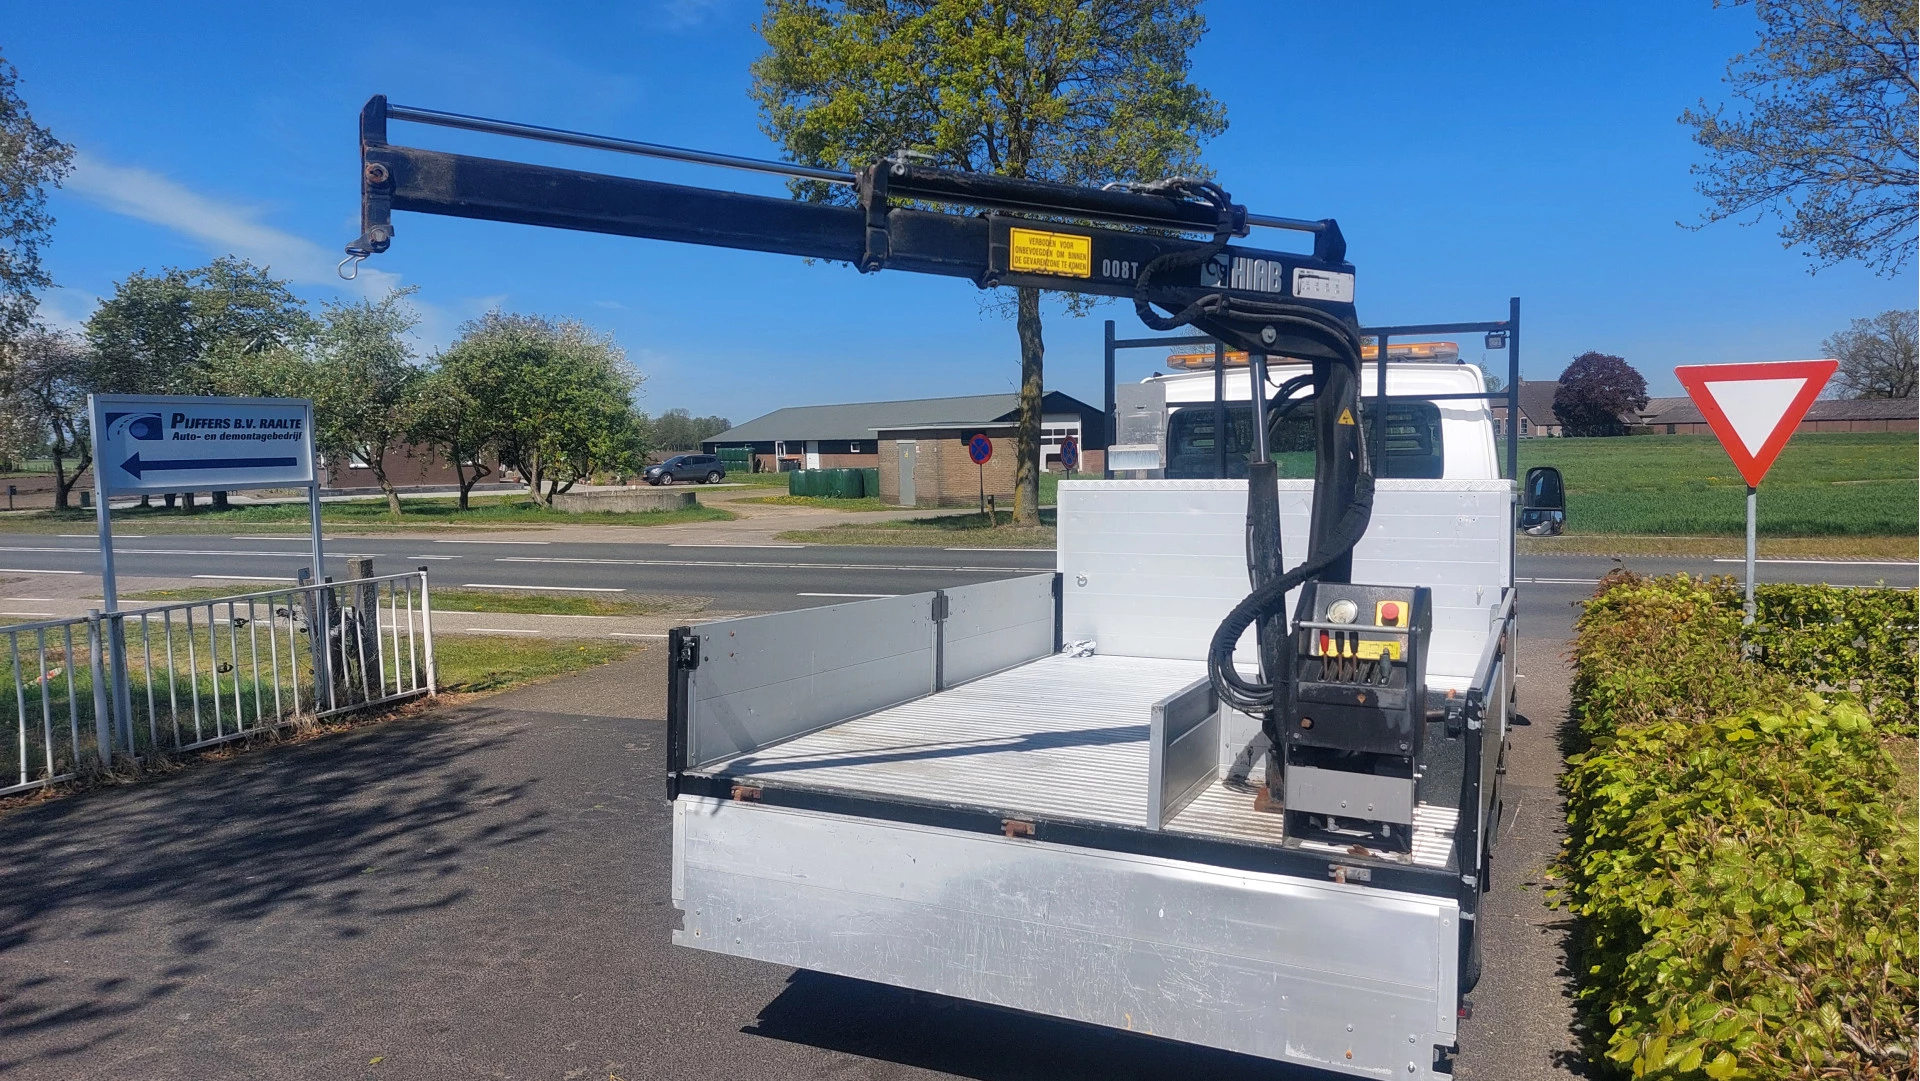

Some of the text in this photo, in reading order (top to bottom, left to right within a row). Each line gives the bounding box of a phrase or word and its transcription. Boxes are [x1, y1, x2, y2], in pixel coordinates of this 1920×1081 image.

[1028, 236, 1074, 250] VERBODEN VOOR
[1014, 245, 1087, 261] ONBEVOEGDEN OM BINNEN
[1014, 256, 1087, 271] DE GEVARENZONE TE KOMEN
[1102, 258, 1139, 280] 008T
[1231, 256, 1283, 293] HIAB
[171, 412, 302, 429] PIJFFERS B.V. RAALTE
[171, 431, 303, 443] Auto- en demontagebedrijf
